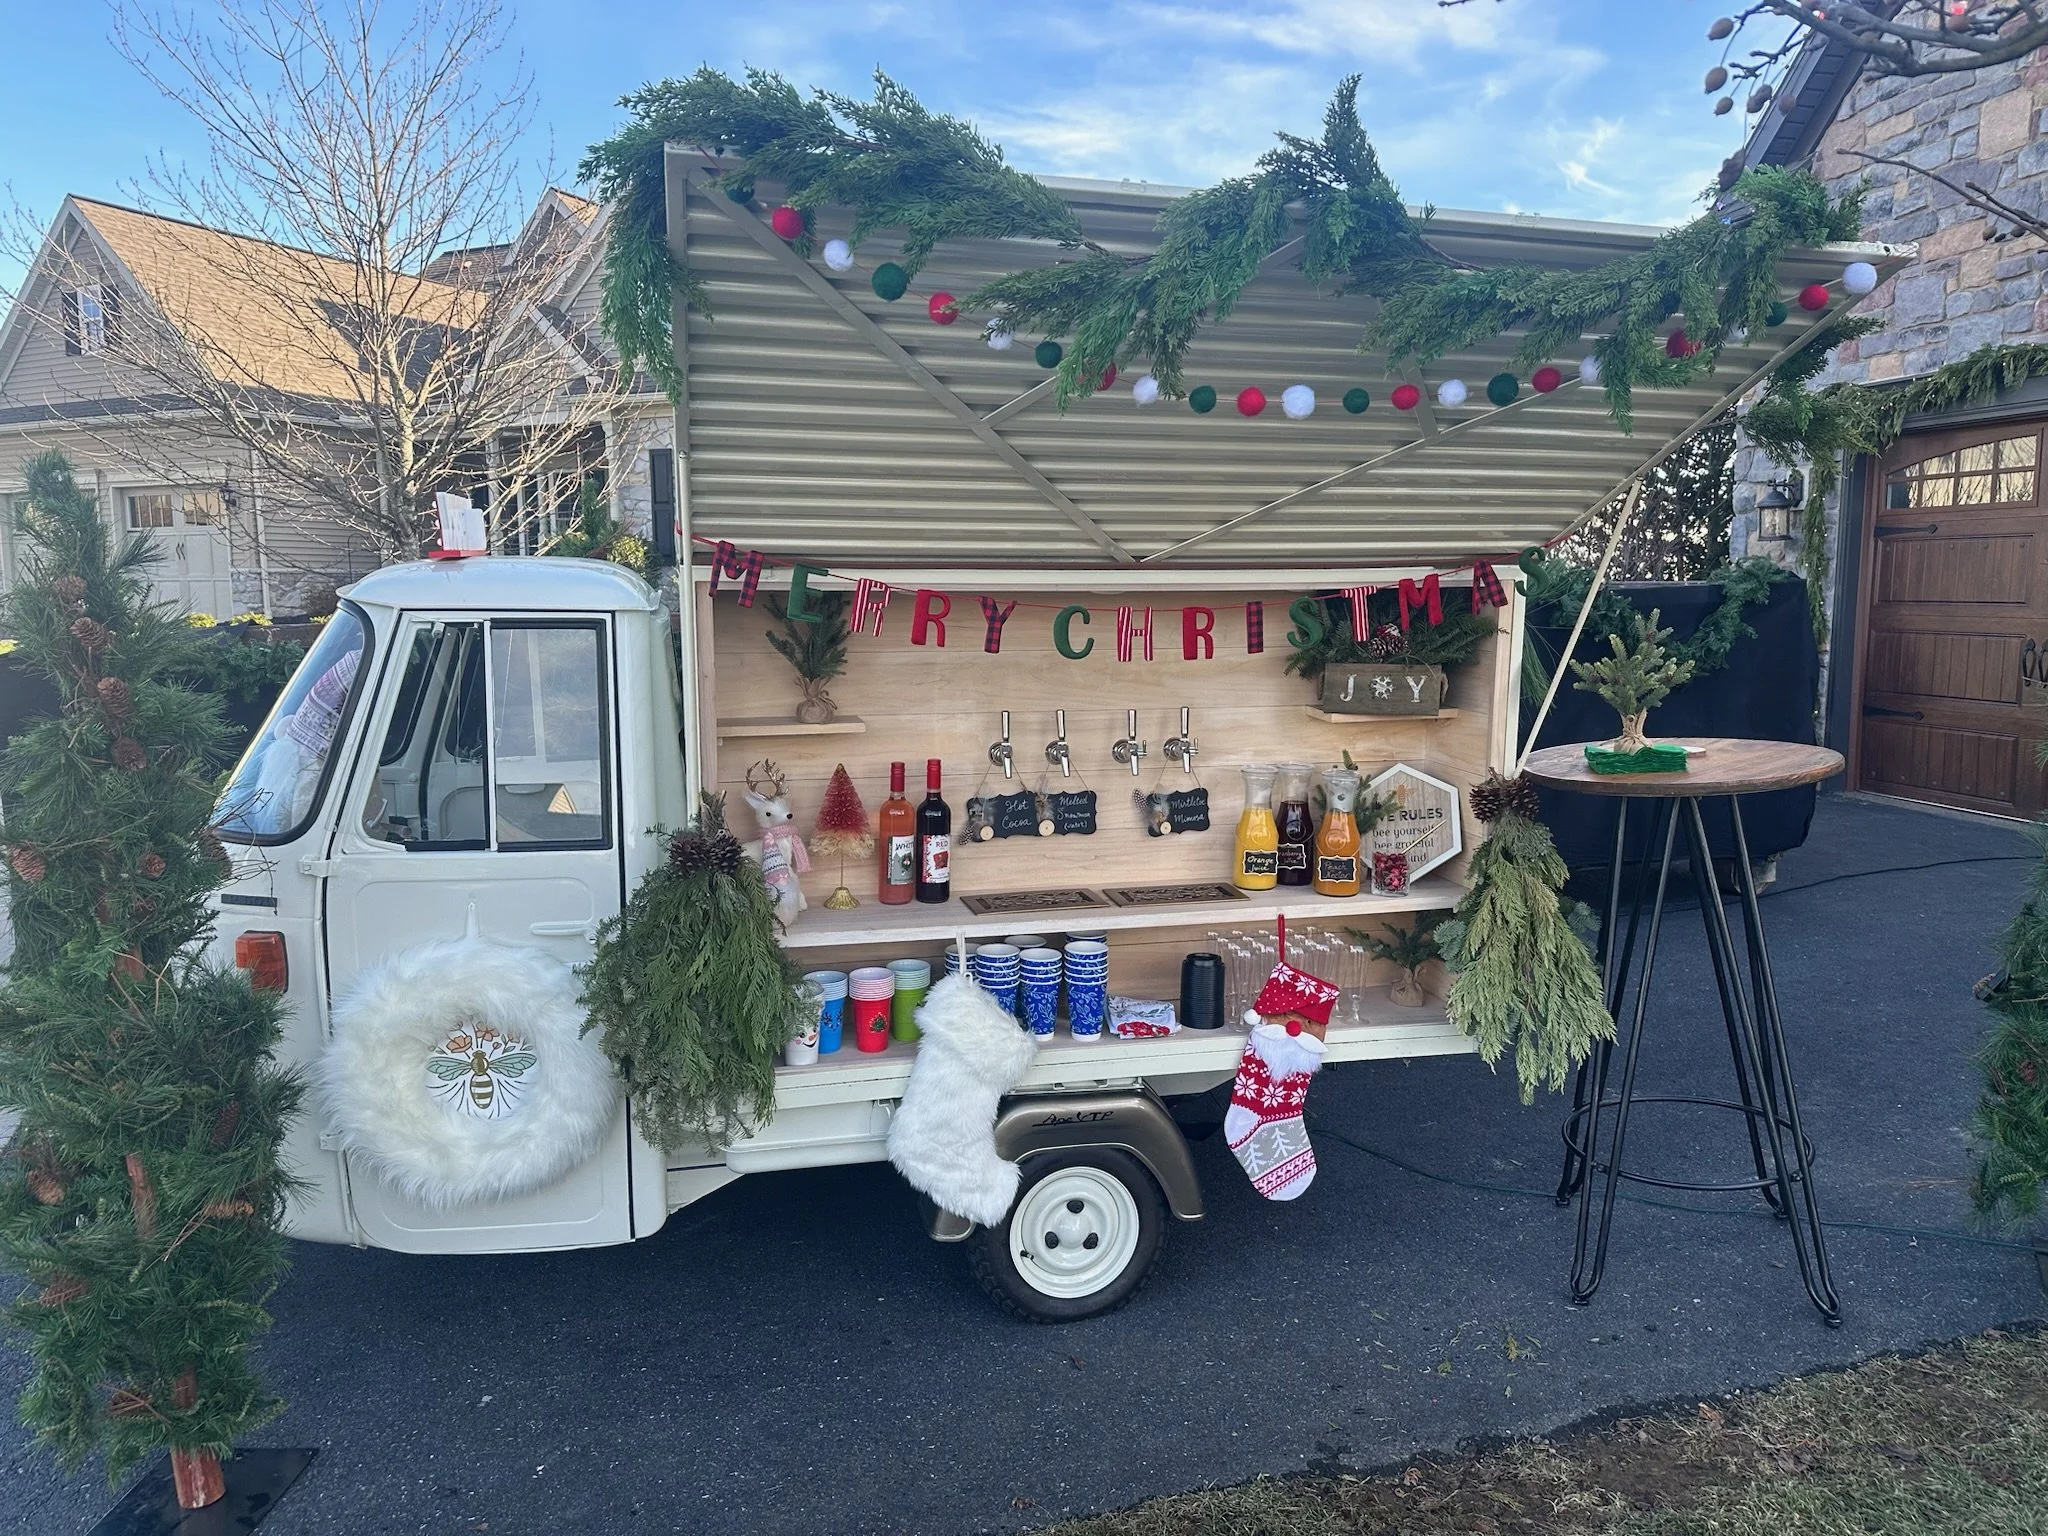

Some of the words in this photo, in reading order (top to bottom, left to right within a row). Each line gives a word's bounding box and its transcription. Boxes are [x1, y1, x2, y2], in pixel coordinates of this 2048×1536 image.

[709, 540, 1018, 654] MERRY
[1053, 546, 1550, 662] CHRISTMAS
[1005, 799, 1029, 814] Hot
[1059, 795, 1089, 807] Melted
[1173, 813, 1205, 824] Mimosa
[1399, 808, 1443, 821] RULES
[1002, 816, 1032, 829] Cocoa
[1372, 828, 1391, 837] bee
[1247, 855, 1274, 865] Orange
[1278, 849, 1303, 860] ranberry
[1323, 861, 1348, 870] Peach
[1322, 868, 1350, 879] Nectar
